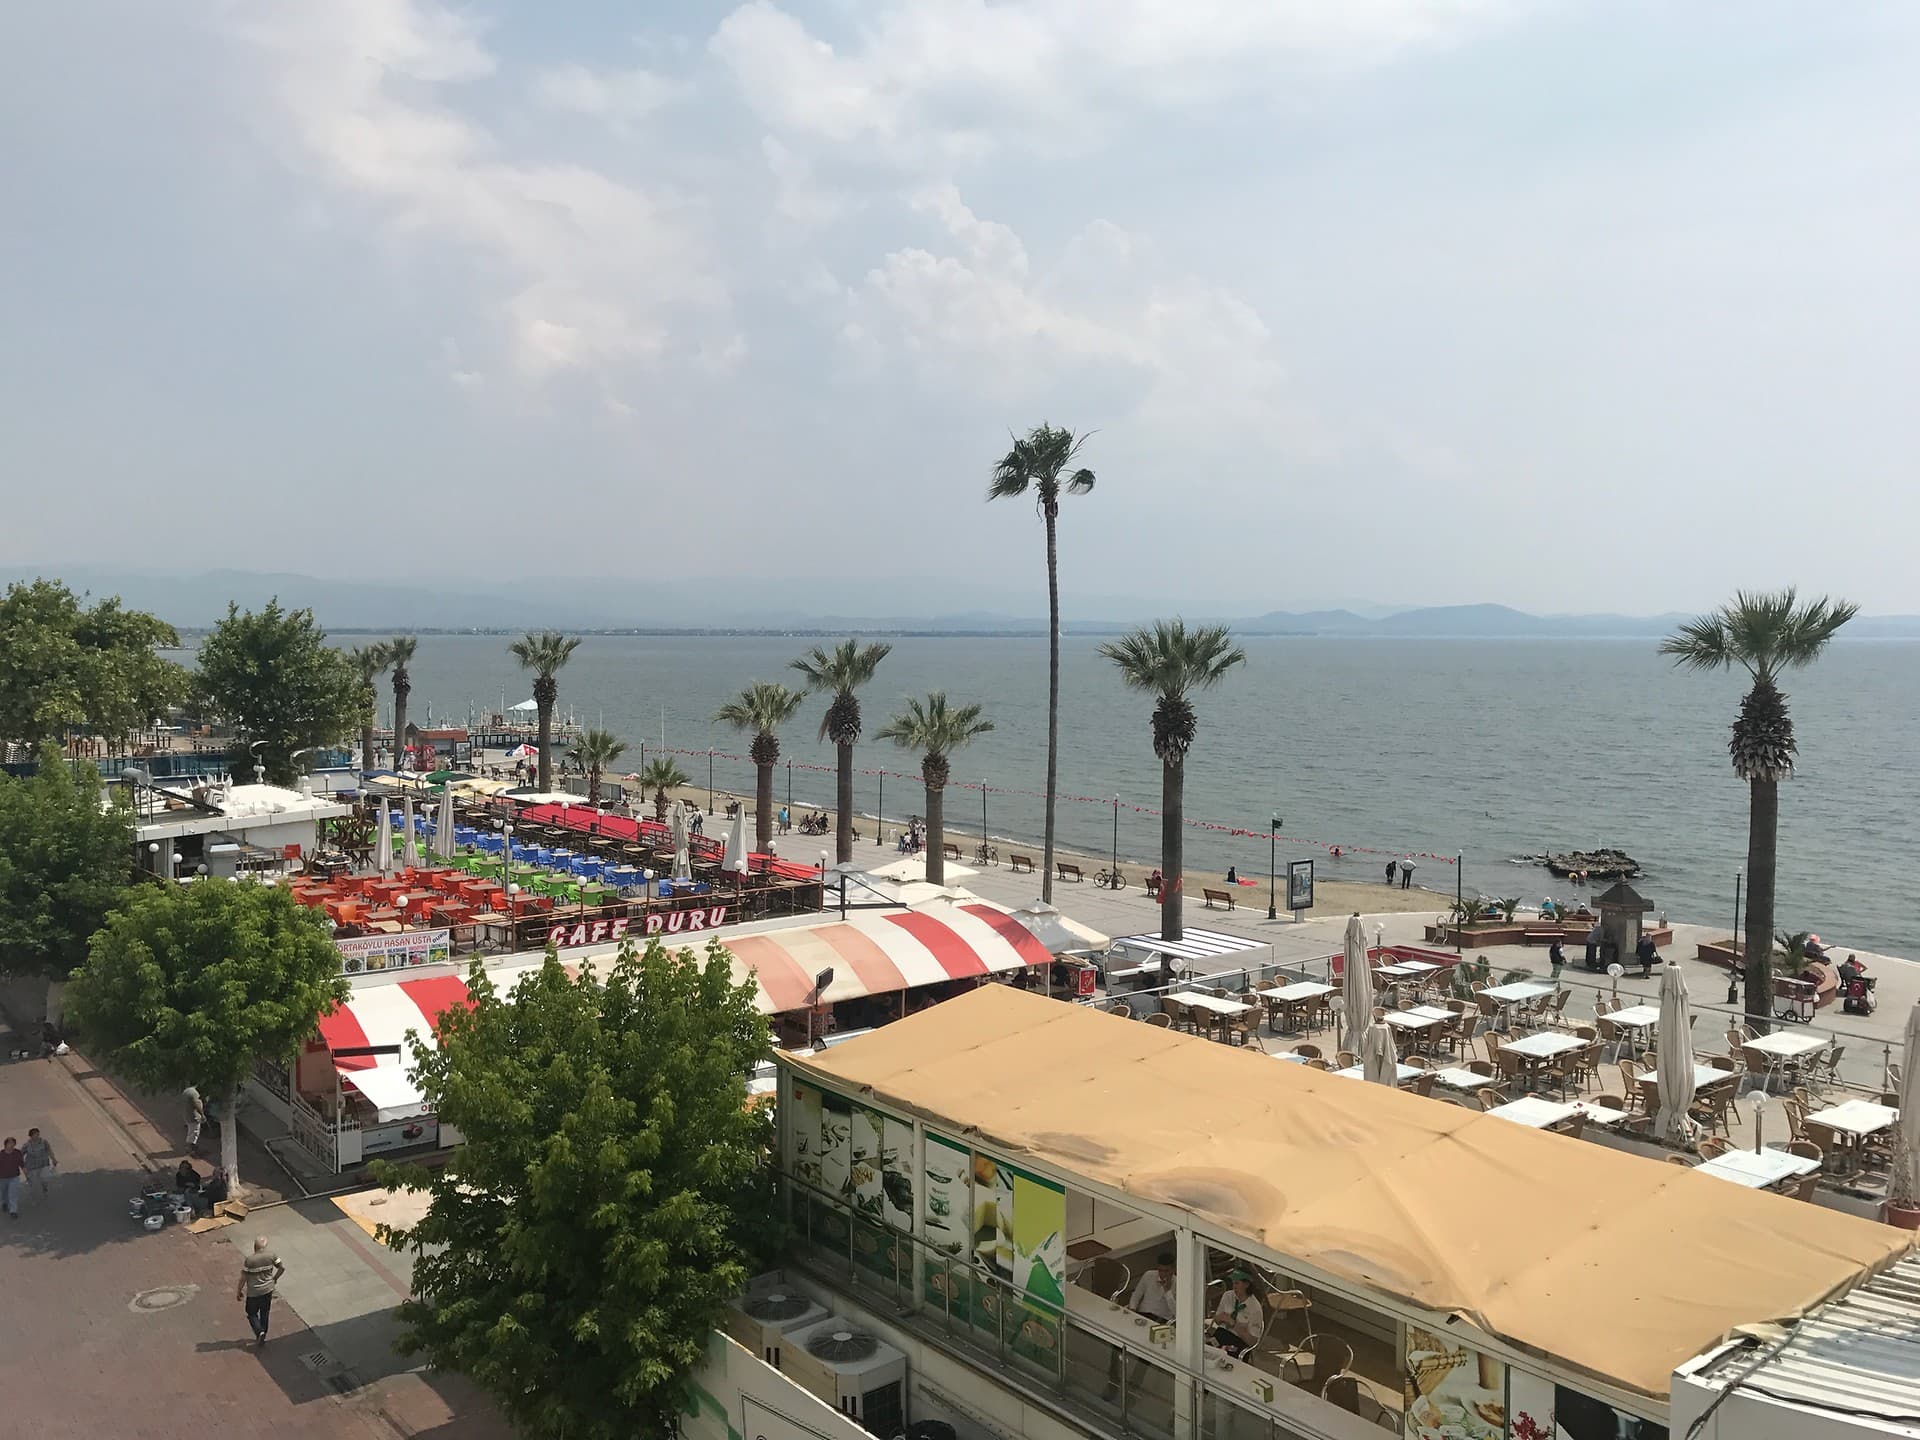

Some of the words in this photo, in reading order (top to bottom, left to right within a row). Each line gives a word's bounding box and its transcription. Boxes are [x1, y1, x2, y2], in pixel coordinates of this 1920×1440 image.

[549, 917, 629, 947] CAFE
[646, 906, 726, 936] DURU
[384, 937, 410, 947] HASAN
[412, 935, 432, 945] USTA
